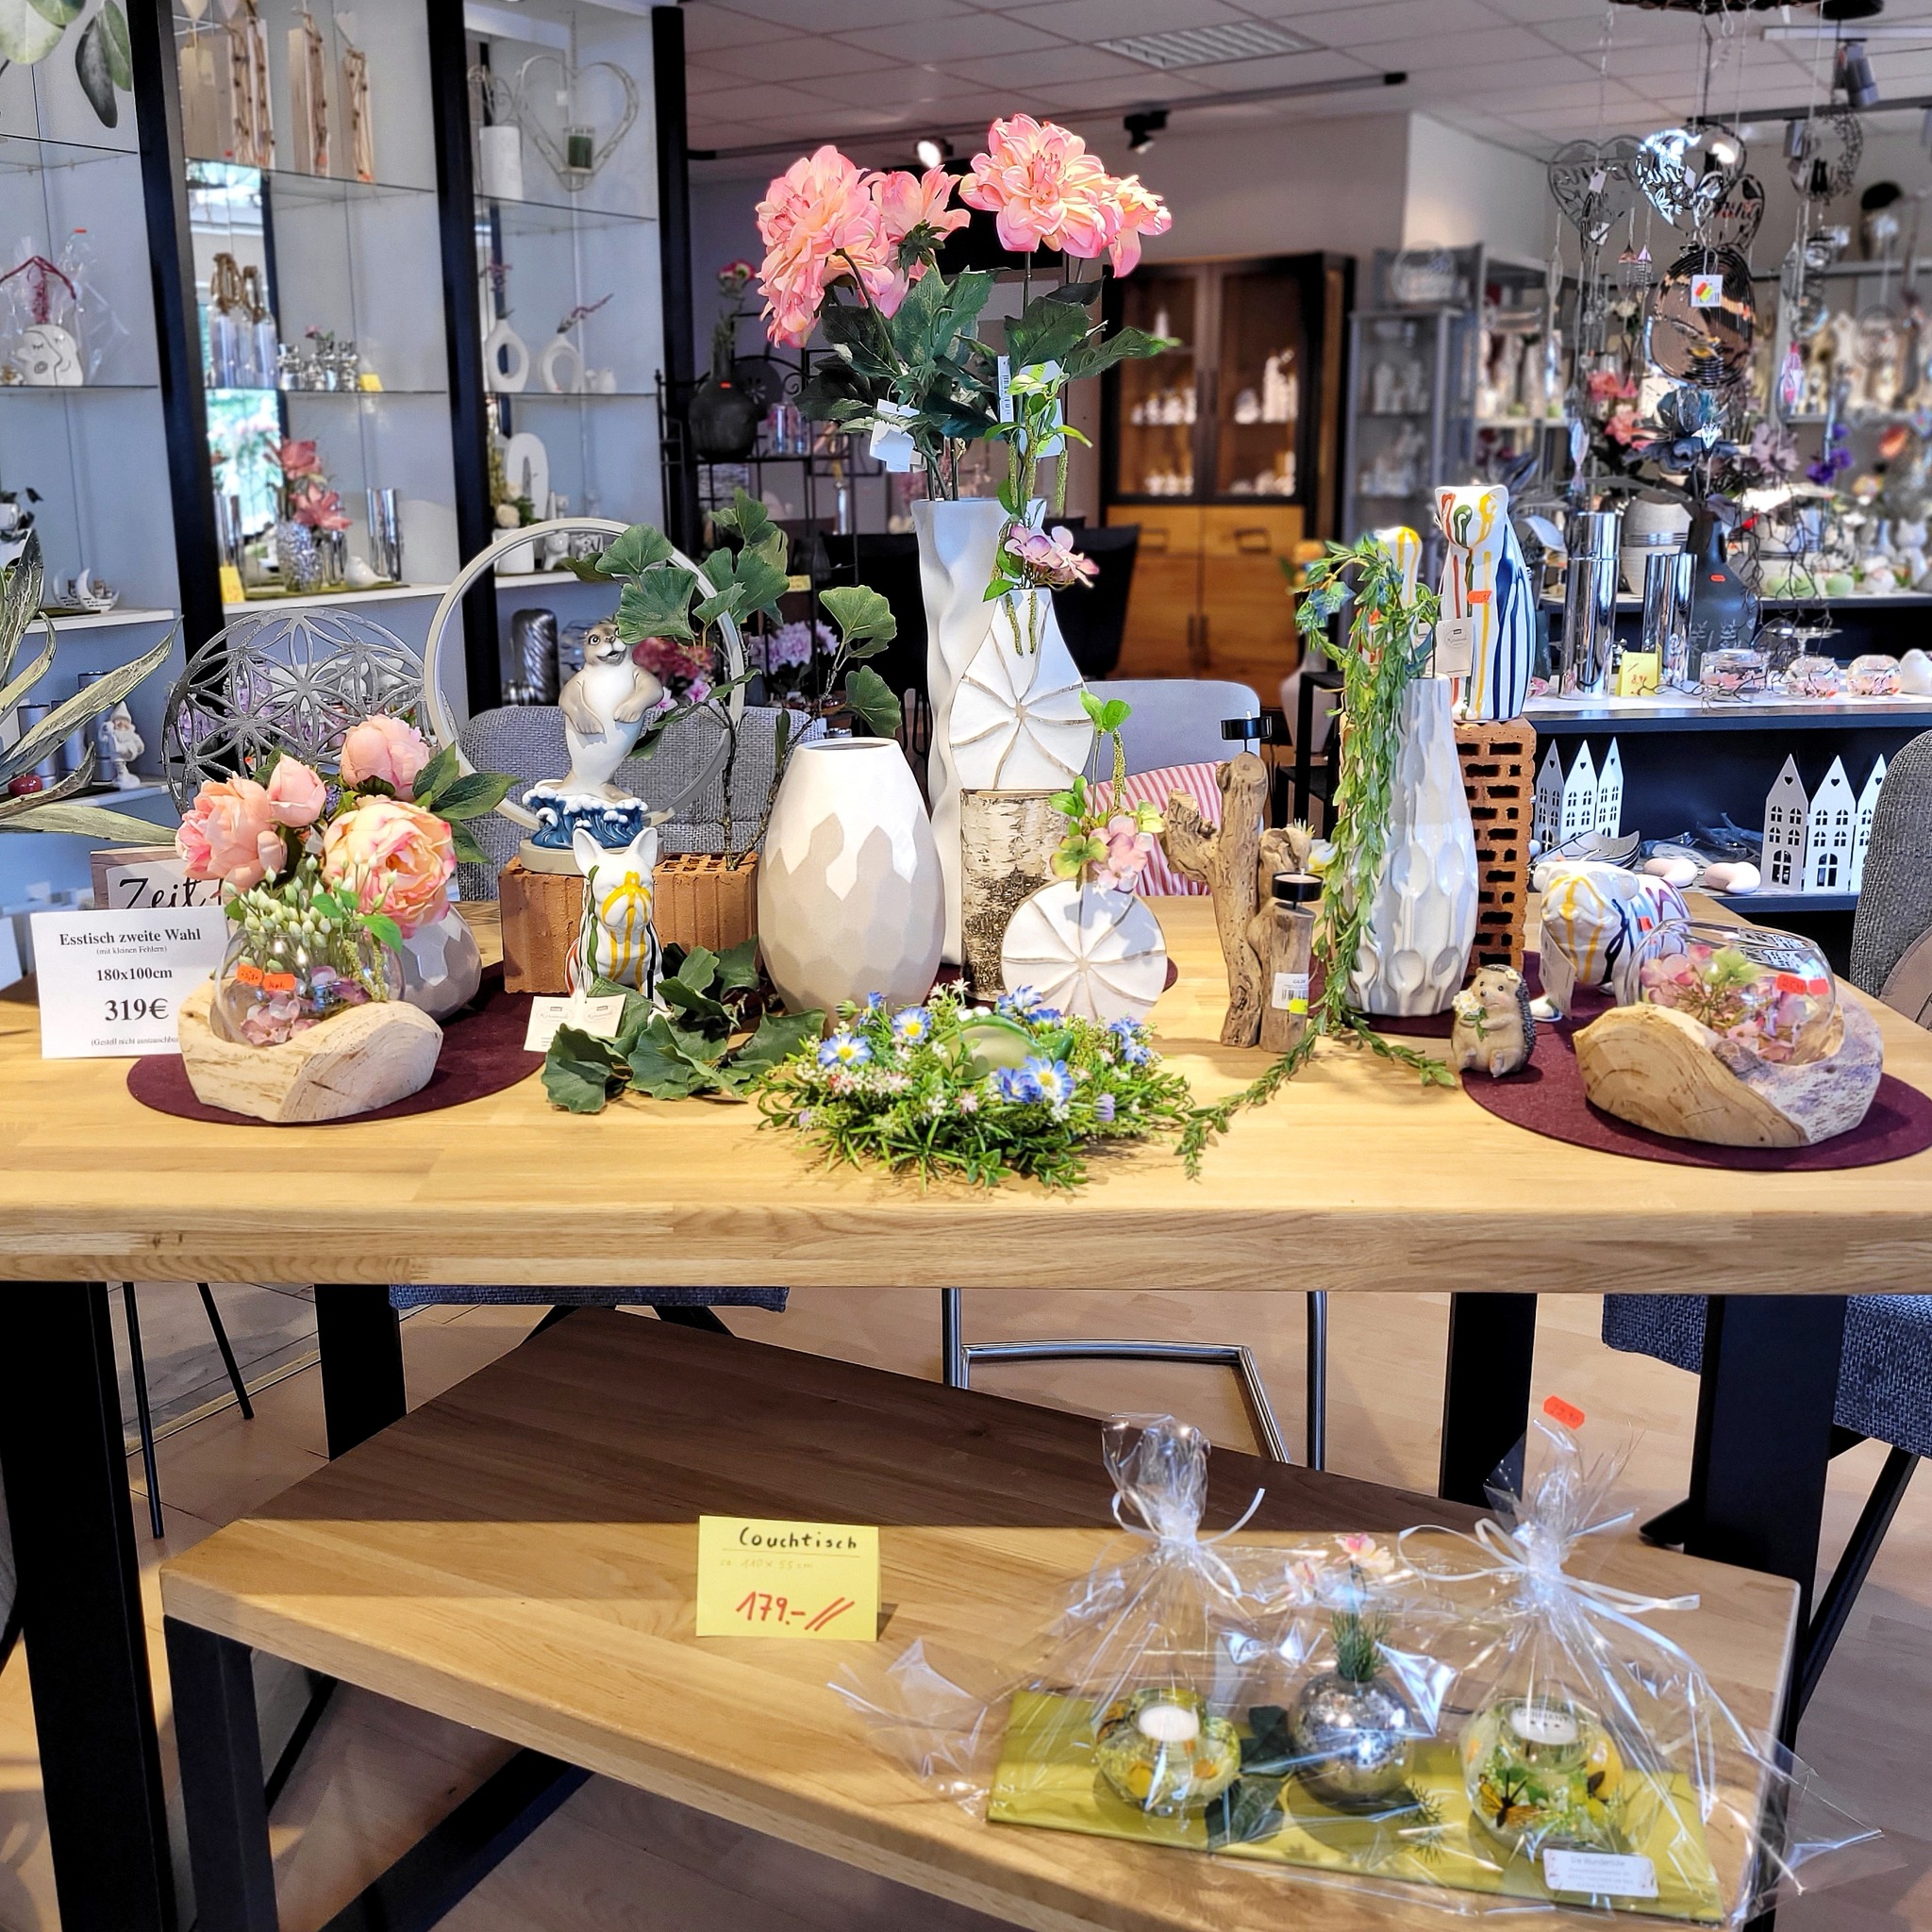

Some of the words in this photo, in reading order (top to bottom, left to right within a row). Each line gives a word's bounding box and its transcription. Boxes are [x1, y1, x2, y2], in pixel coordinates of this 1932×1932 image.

[119, 876, 207, 908] Zeit
[59, 932, 114, 945] Esstisch
[119, 929, 161, 942] zweite
[165, 928, 201, 941] Wahl
[96, 947, 111, 956] (mit
[113, 946, 137, 955] kleinen
[139, 945, 168, 954] Fehlern)
[97, 967, 173, 981] 180x100cm
[105, 997, 170, 1021] 319€
[739, 1526, 858, 1549] Couchtisch
